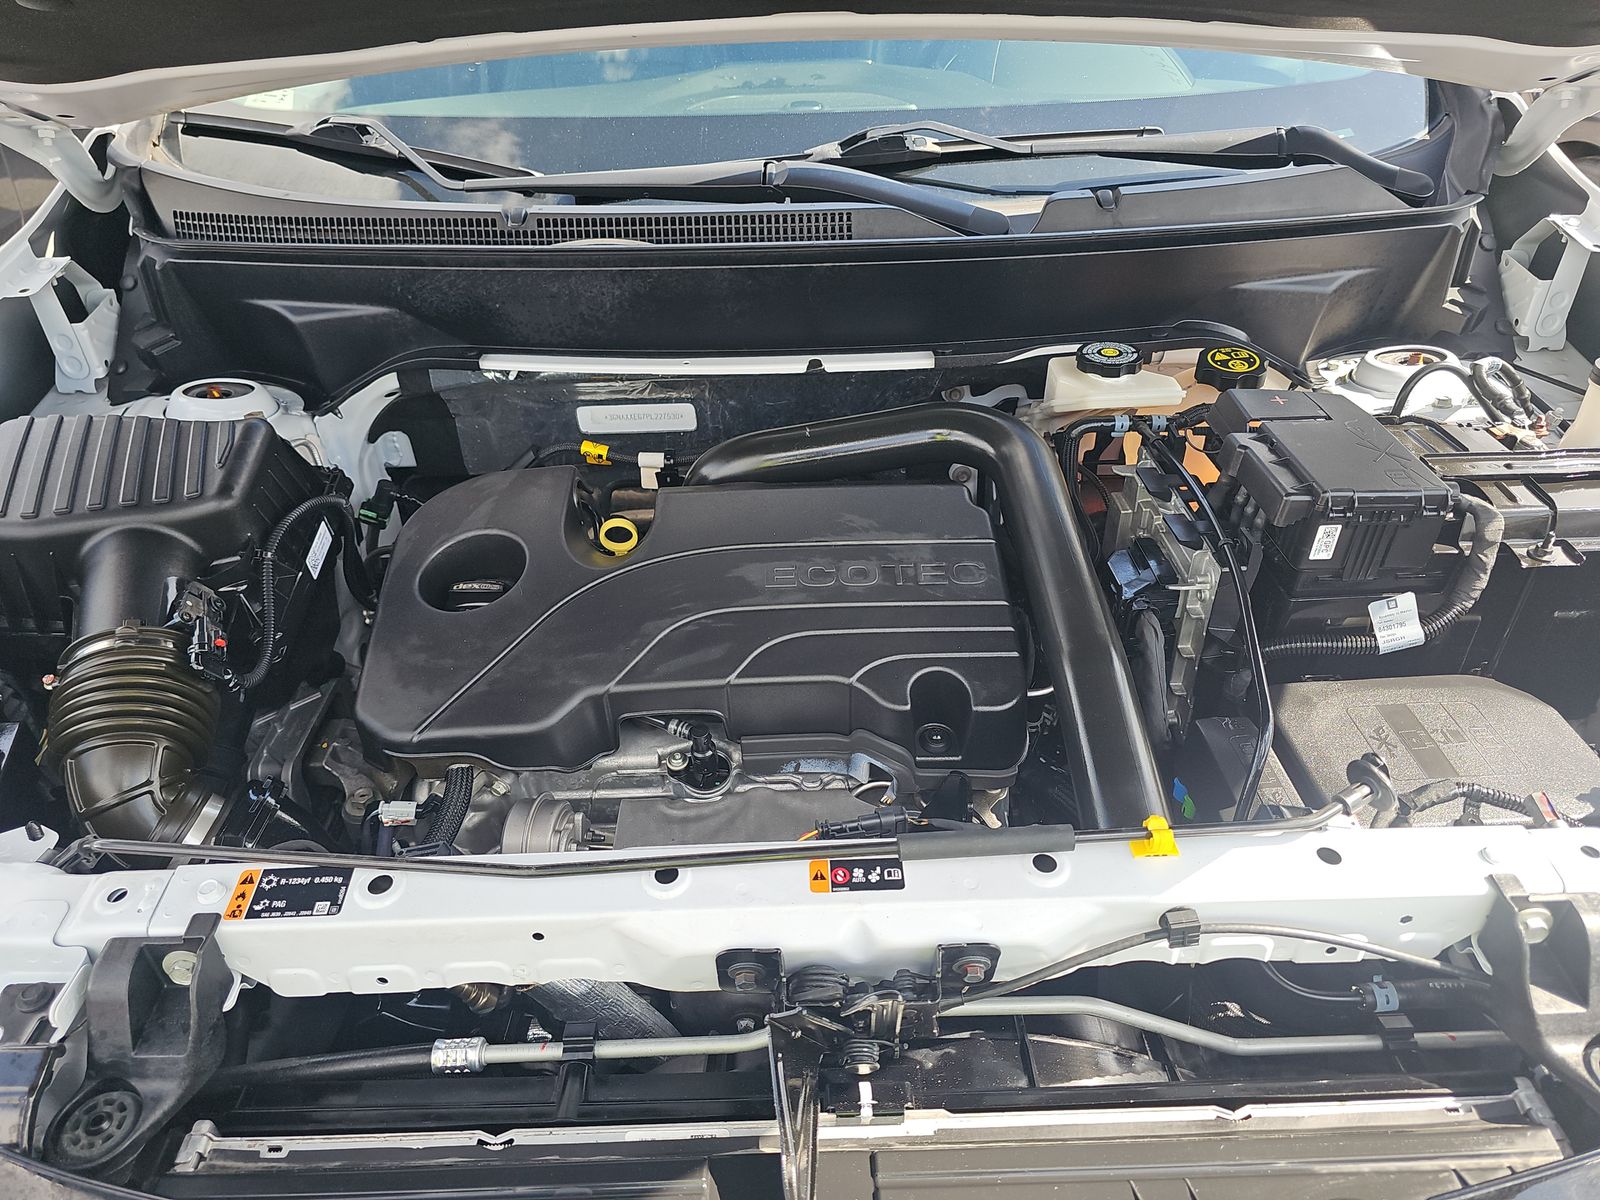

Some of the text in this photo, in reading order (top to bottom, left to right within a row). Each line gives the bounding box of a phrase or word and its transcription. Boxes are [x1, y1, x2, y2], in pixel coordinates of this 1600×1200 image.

[765, 561, 988, 588] ECOTEC
[280, 876, 343, 886] R-1234yf 0.450 kg
[271, 900, 287, 908] PAG
